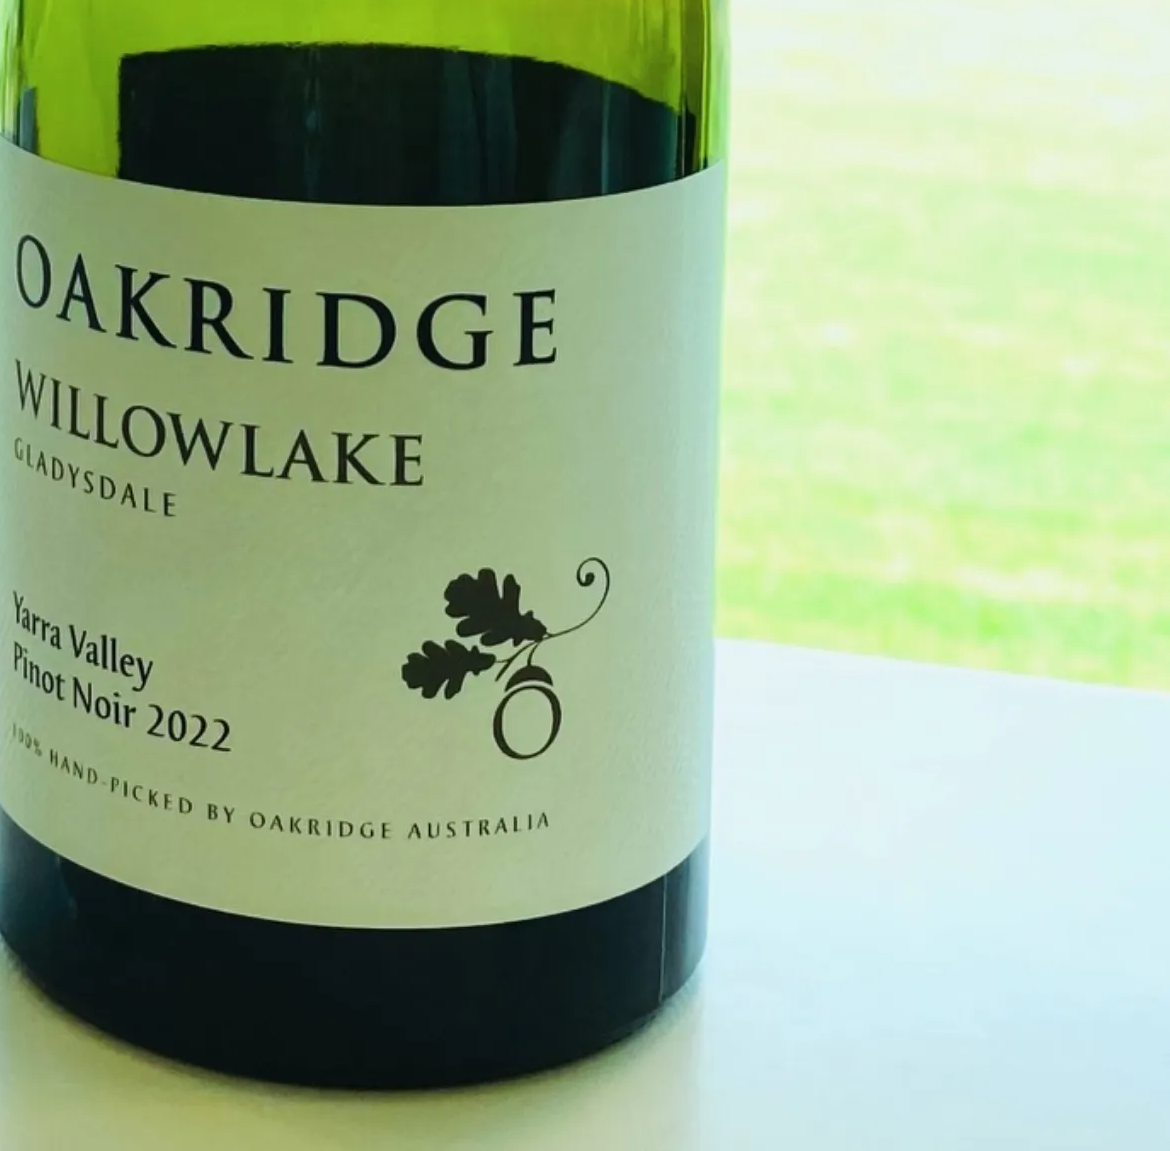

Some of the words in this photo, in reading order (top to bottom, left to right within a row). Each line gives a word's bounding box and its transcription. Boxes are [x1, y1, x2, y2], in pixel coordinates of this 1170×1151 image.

[16, 233, 558, 371] OAKRIDGE
[13, 436, 177, 518] GLADYSDALE
[14, 358, 425, 488] WILLOWLAKE
[12, 589, 62, 651] Yarra
[68, 623, 154, 693] Valley
[13, 640, 66, 701] Pinot
[72, 675, 137, 729] Noir
[146, 703, 233, 753] 2022
[48, 747, 194, 816] HAND-PICKED
[206, 802, 236, 825] BY
[248, 810, 392, 841] OAKRIDGE
[406, 810, 551, 840] AUSTRALIA
